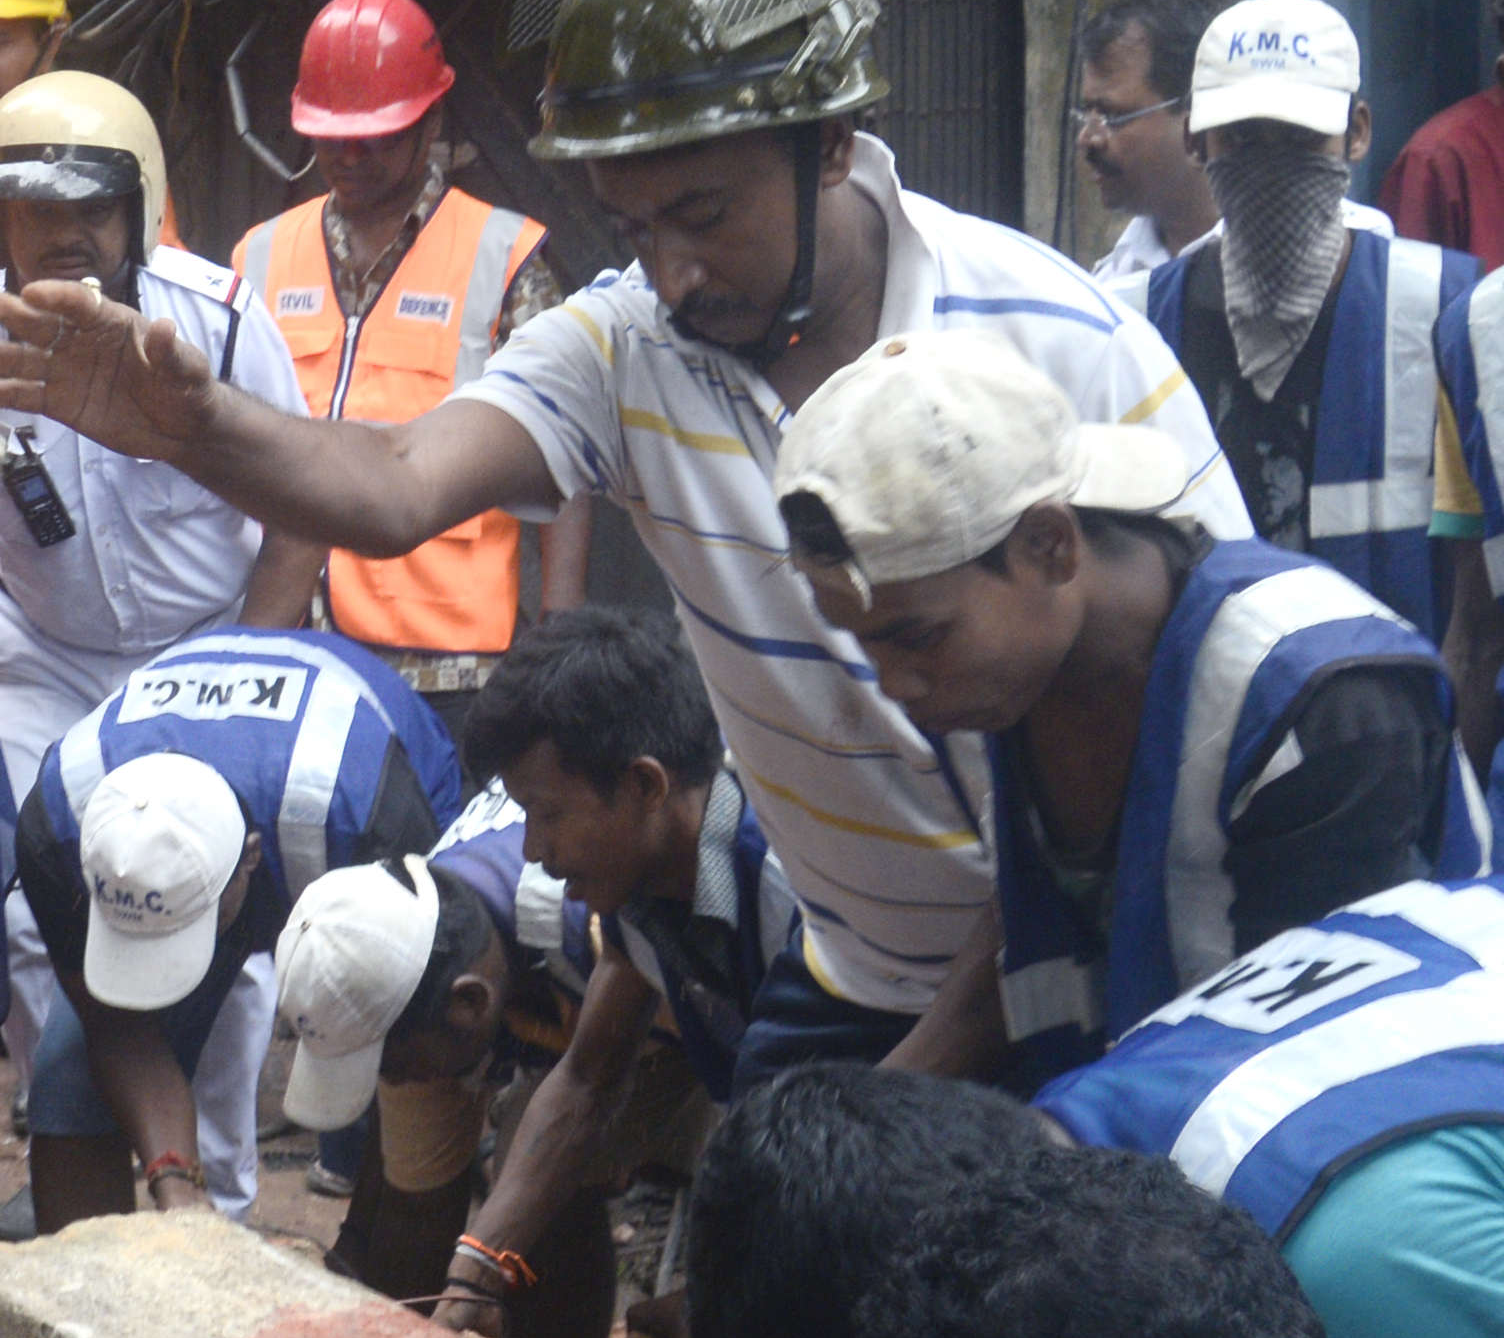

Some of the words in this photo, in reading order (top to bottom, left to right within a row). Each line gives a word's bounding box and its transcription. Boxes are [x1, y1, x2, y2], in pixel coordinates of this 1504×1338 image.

[1227, 31, 1316, 66] K.M.C.
[280, 292, 315, 310] CIVIL
[398, 295, 451, 320] DEFENCE
[143, 675, 287, 710] K.M.C.
[94, 869, 172, 916] K.M.C.
